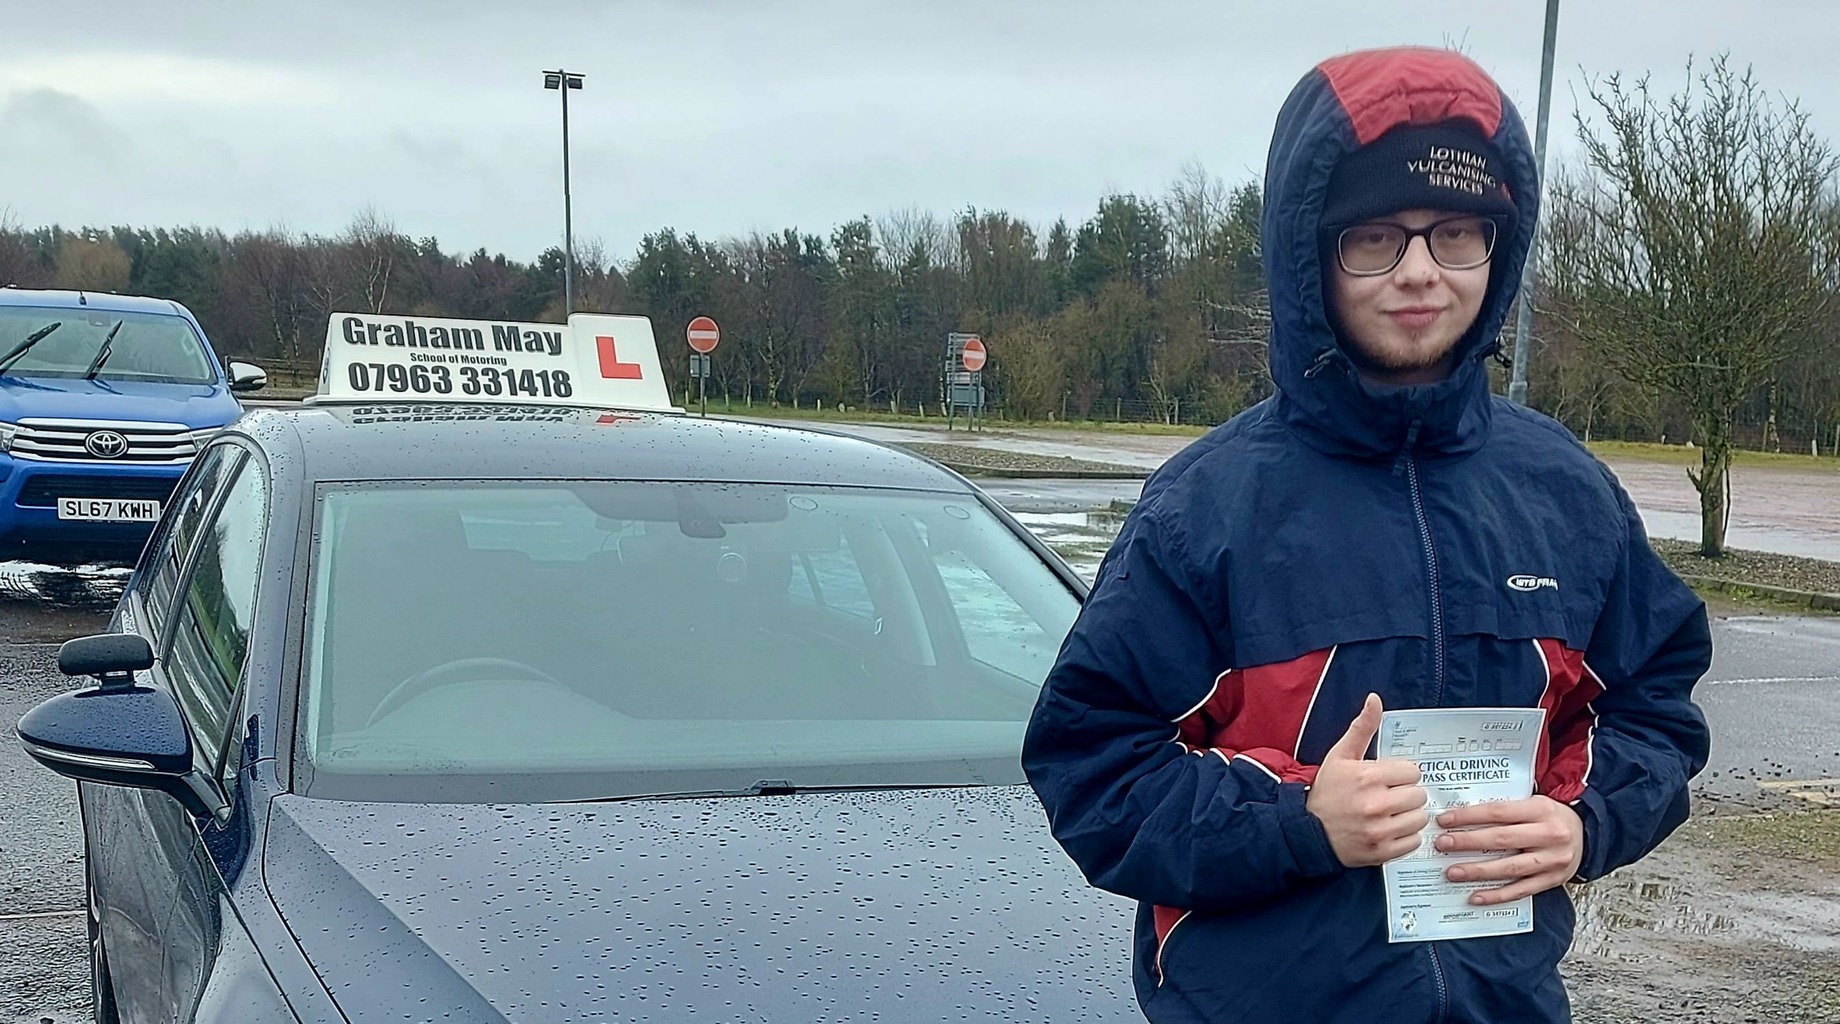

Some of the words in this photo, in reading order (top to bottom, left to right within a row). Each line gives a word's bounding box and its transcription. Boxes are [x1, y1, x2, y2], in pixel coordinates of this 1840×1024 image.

[1430, 145, 1487, 170] LOTHIAN
[1407, 160, 1496, 188] VULCANISING
[1428, 173, 1483, 196] SERVICES
[341, 316, 486, 351] Graham
[494, 325, 563, 356] May
[409, 352, 446, 363] School
[448, 354, 459, 364] of
[460, 355, 508, 367] Motoring
[594, 336, 644, 380] L
[347, 362, 453, 394] 07963
[459, 366, 573, 399] 331418
[65, 500, 113, 517] SL67
[117, 502, 153, 519] KWH
[1415, 759, 1457, 773] CTICAL
[1460, 757, 1510, 770] DRIVING
[1423, 771, 1446, 783] PASS
[1448, 769, 1511, 782] CERTIFICATE
